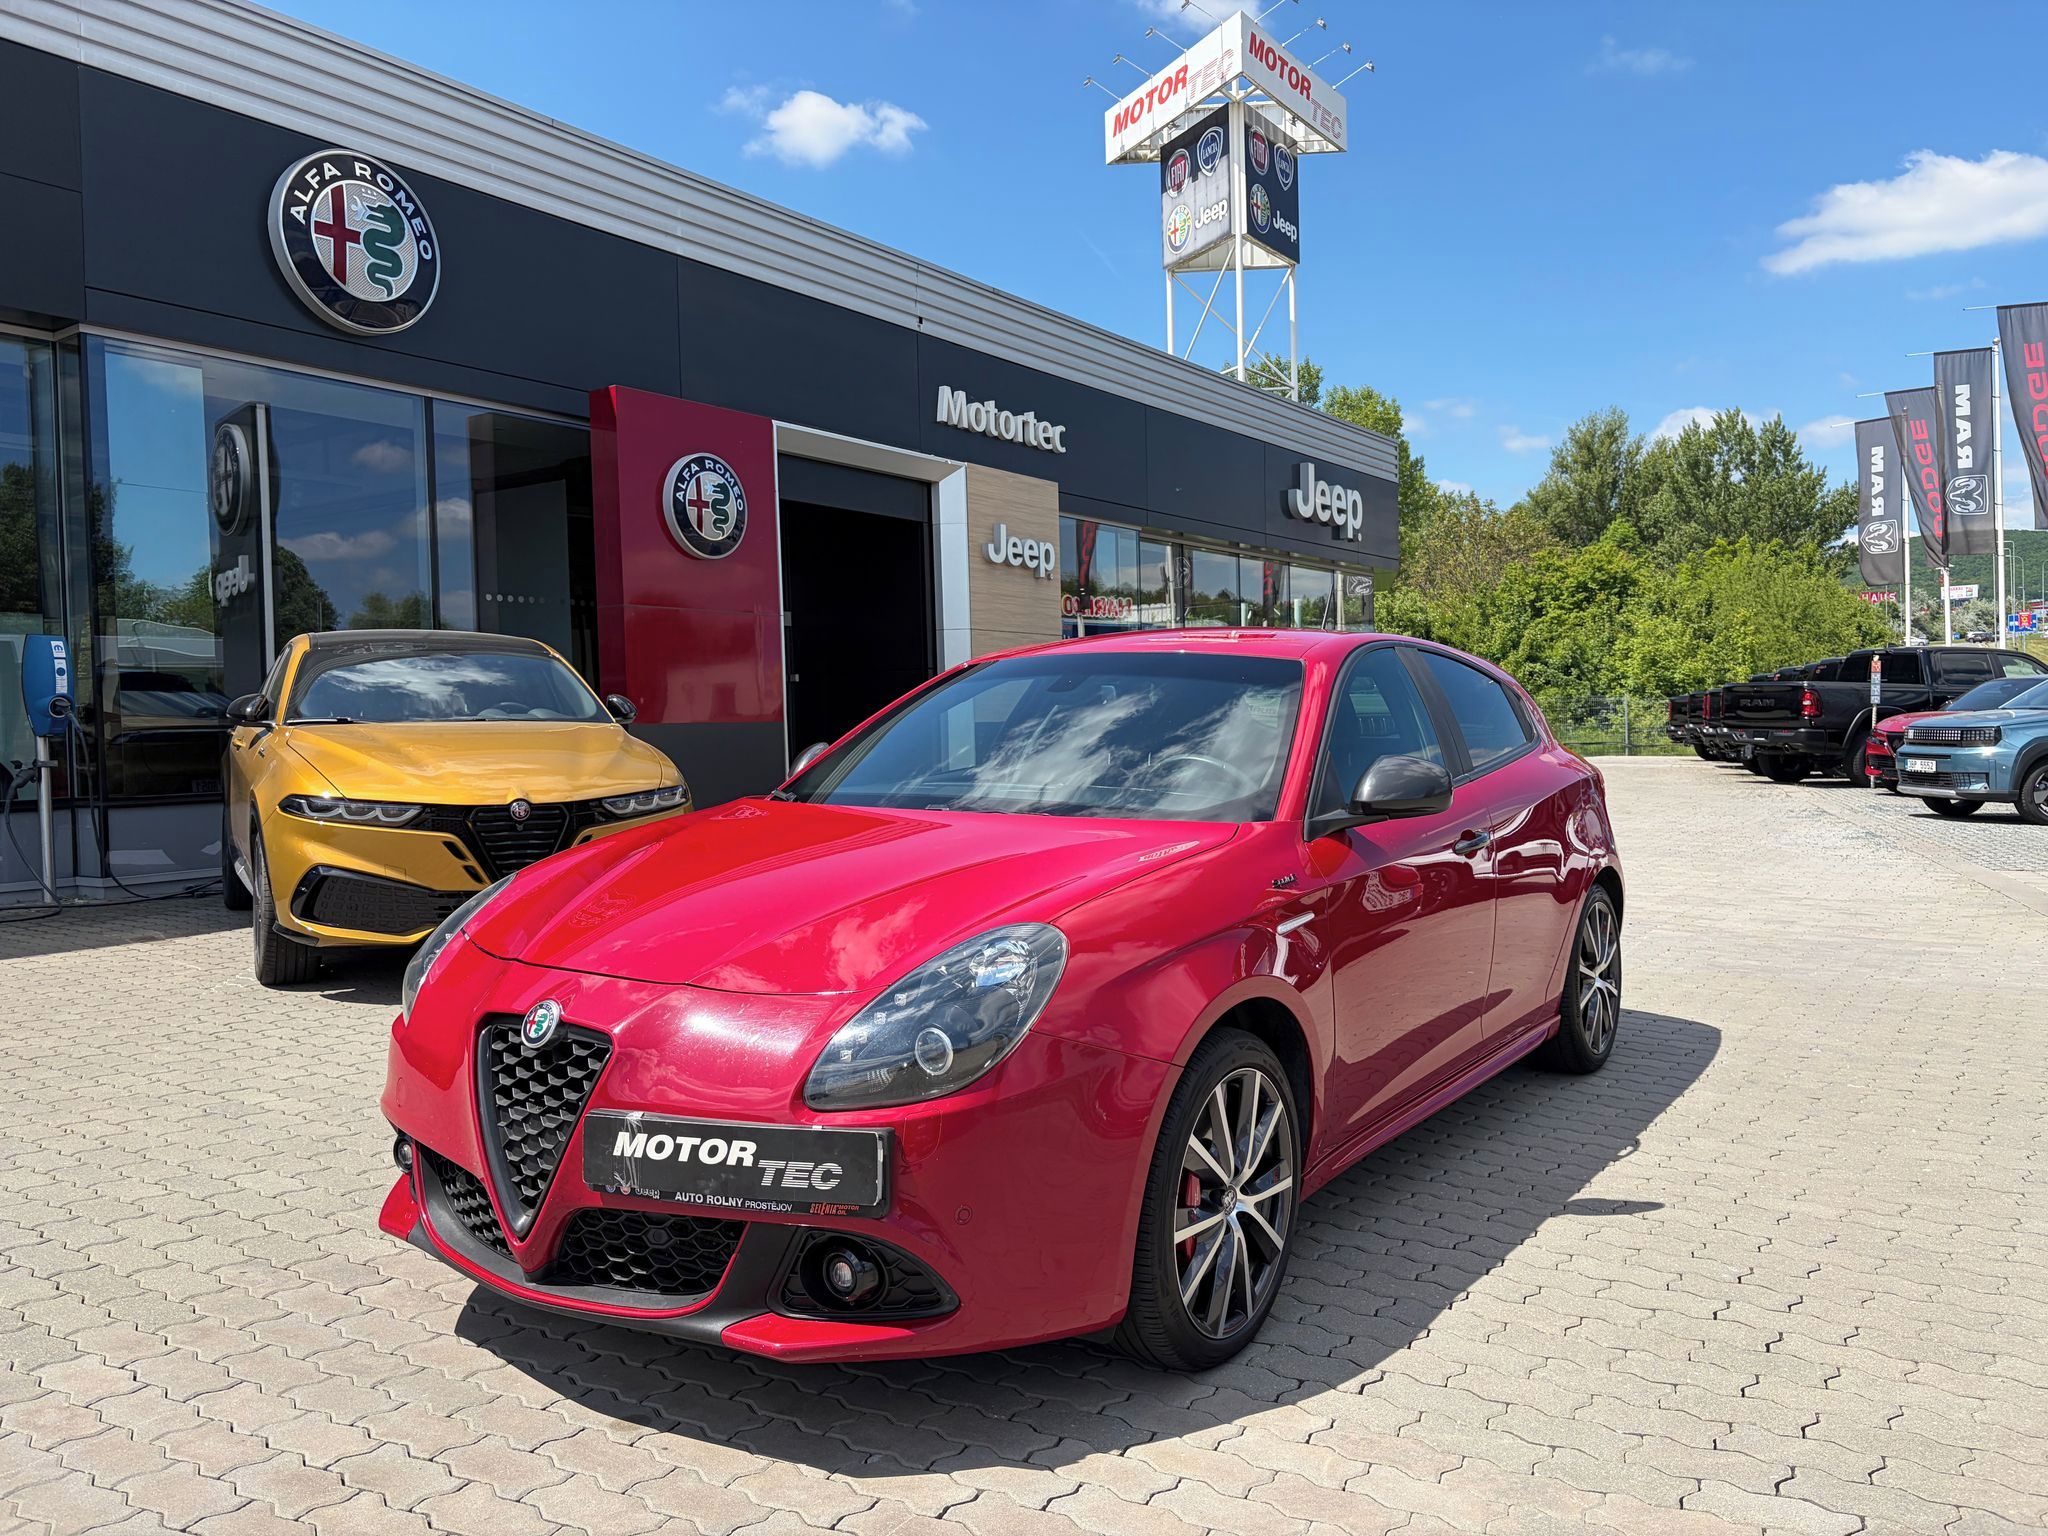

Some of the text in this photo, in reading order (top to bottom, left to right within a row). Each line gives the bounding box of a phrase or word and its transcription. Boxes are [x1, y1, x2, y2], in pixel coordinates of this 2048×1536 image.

[1113, 48, 1234, 138] MOTOR TEC
[1249, 31, 1343, 140] MOTOR TEC
[1171, 160, 1186, 187] FIAT
[290, 161, 433, 261] ALFA ROMEO
[1195, 199, 1228, 229] Jeep
[1272, 209, 1298, 243] Jeep
[937, 385, 1067, 454] Motortec
[676, 459, 744, 511] ALFA ROMEO
[1288, 462, 1364, 541] Jeep
[982, 523, 1056, 579] Jeep
[1739, 698, 1775, 707] RAM
[613, 1131, 843, 1191] MOTOR TEC
[675, 1191, 793, 1212] AUTO ROLNY PROSTĚJOV
